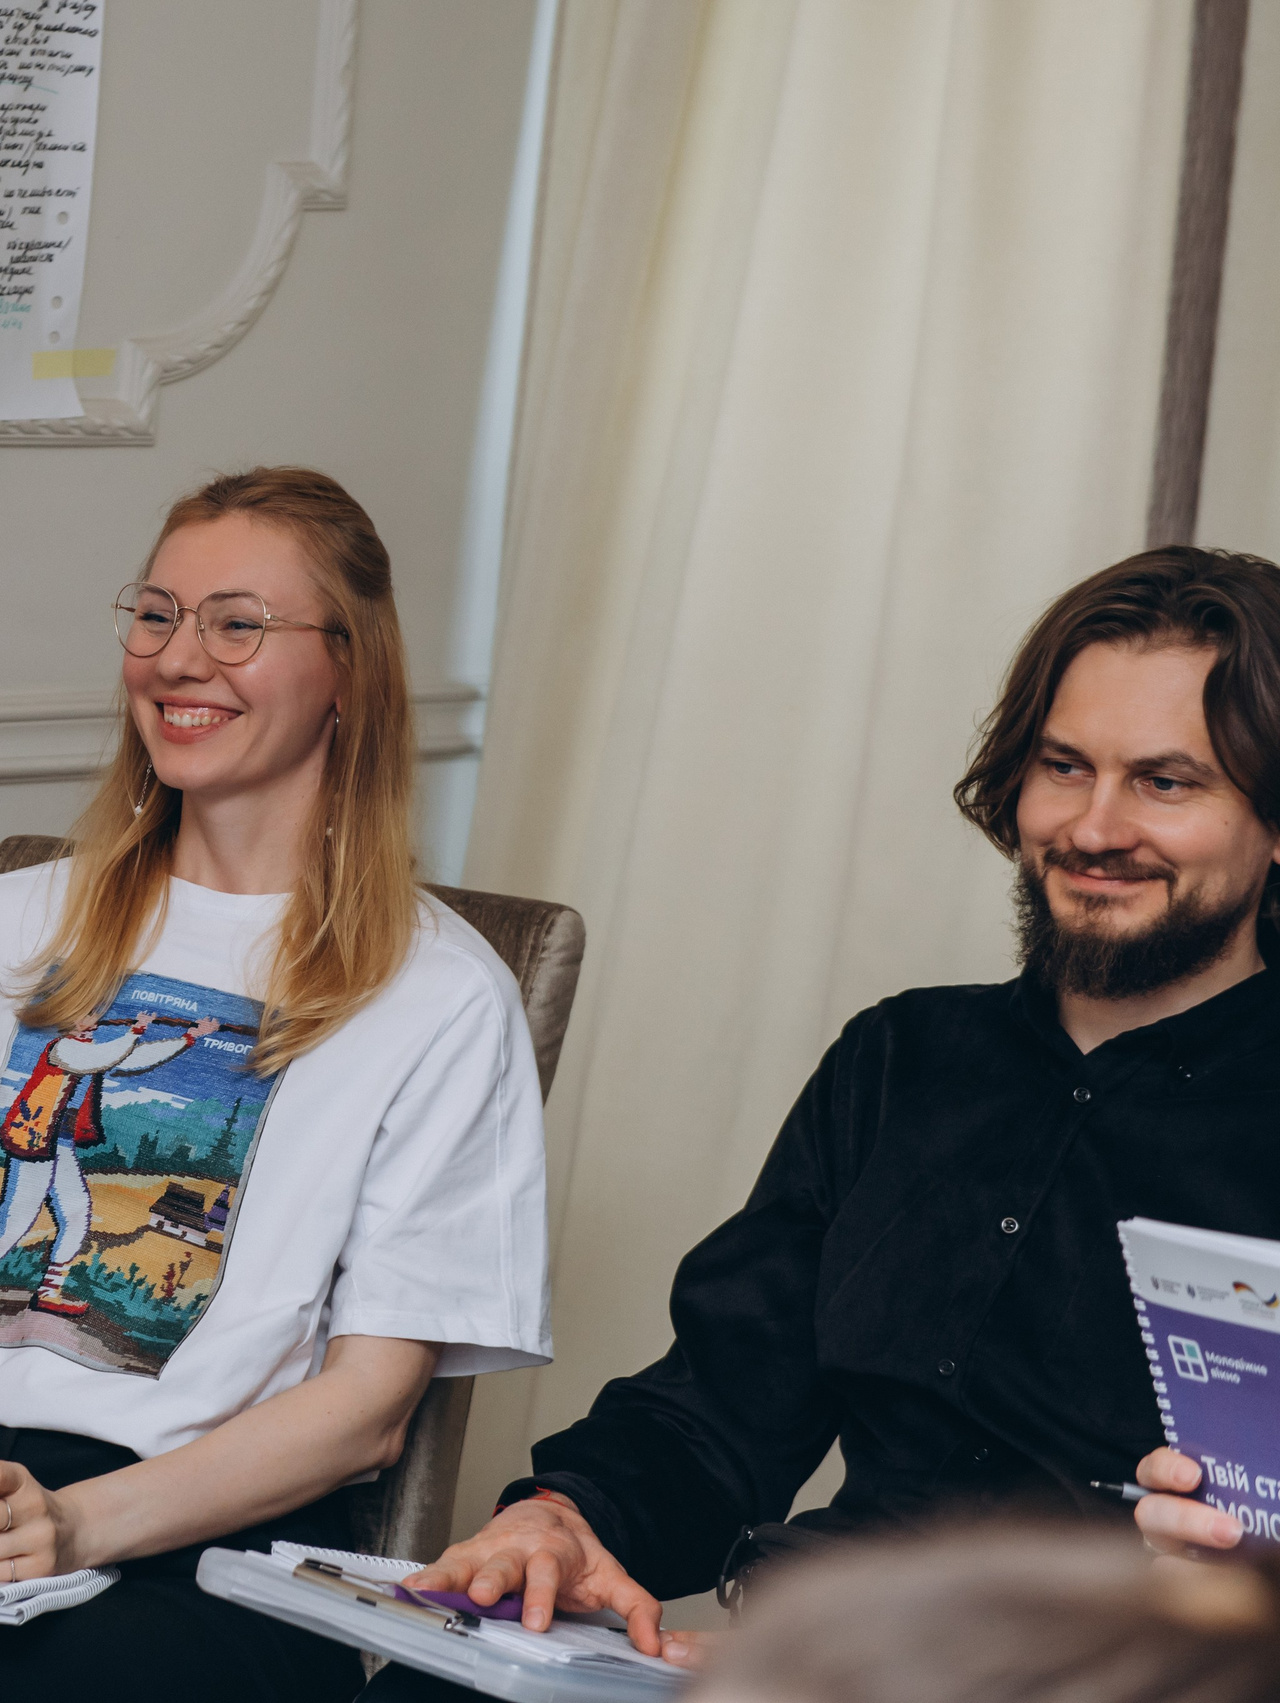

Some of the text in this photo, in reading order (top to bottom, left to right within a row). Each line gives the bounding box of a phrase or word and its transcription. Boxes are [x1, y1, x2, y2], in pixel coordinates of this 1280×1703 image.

[131, 989, 199, 1013] ПОВІТРЯНА
[203, 1036, 253, 1055] ТРИВОГ
[1210, 1366, 1241, 1384] вікно
[1201, 1455, 1280, 1501] Твій ст
